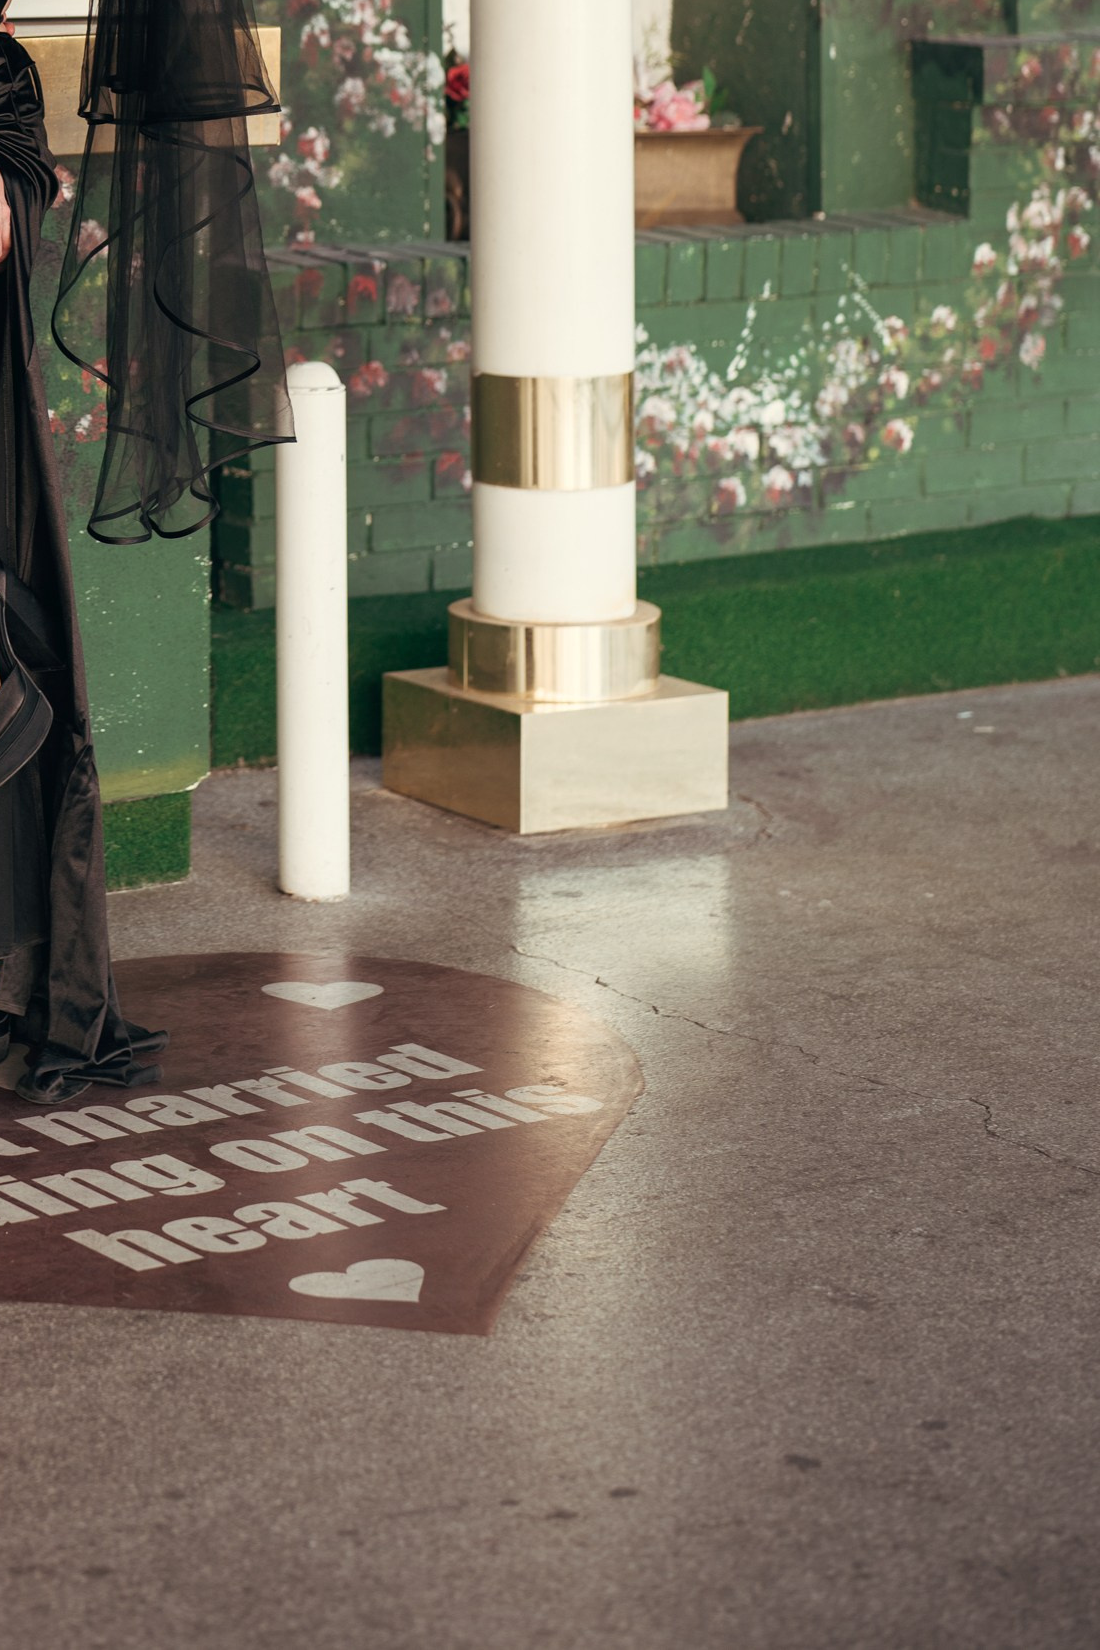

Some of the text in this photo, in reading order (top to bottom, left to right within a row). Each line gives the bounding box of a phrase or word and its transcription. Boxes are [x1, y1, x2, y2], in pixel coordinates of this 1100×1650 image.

[15, 1042, 484, 1146] married
[208, 1124, 388, 1173] on
[355, 1084, 604, 1143] this
[63, 1177, 448, 1272] heart
